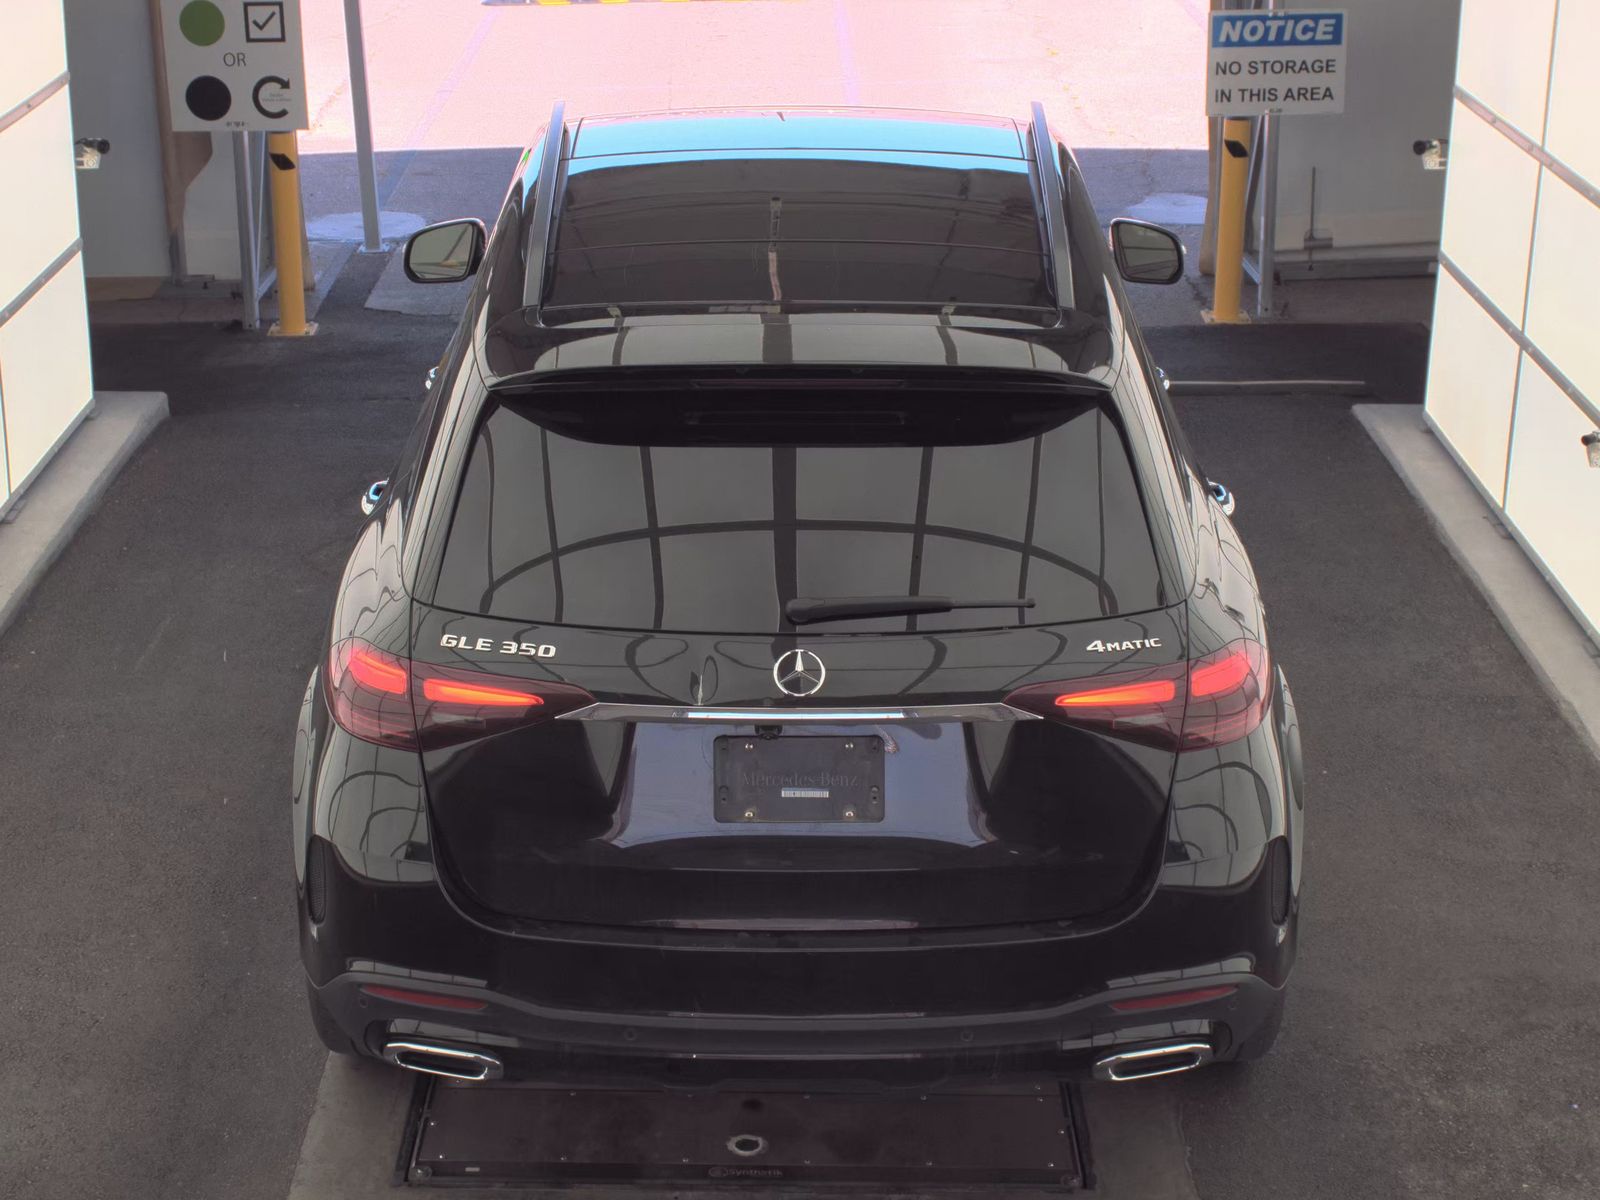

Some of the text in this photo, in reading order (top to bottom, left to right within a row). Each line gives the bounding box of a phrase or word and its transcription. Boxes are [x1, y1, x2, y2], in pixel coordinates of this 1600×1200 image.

[1219, 19, 1336, 42] NOTICE
[223, 52, 247, 67] OR
[1215, 59, 1336, 75] NO STORAGE
[1215, 86, 1334, 102] IN THIS AREA
[440, 634, 556, 658] GLE 350
[1086, 638, 1162, 653] 4MATIC
